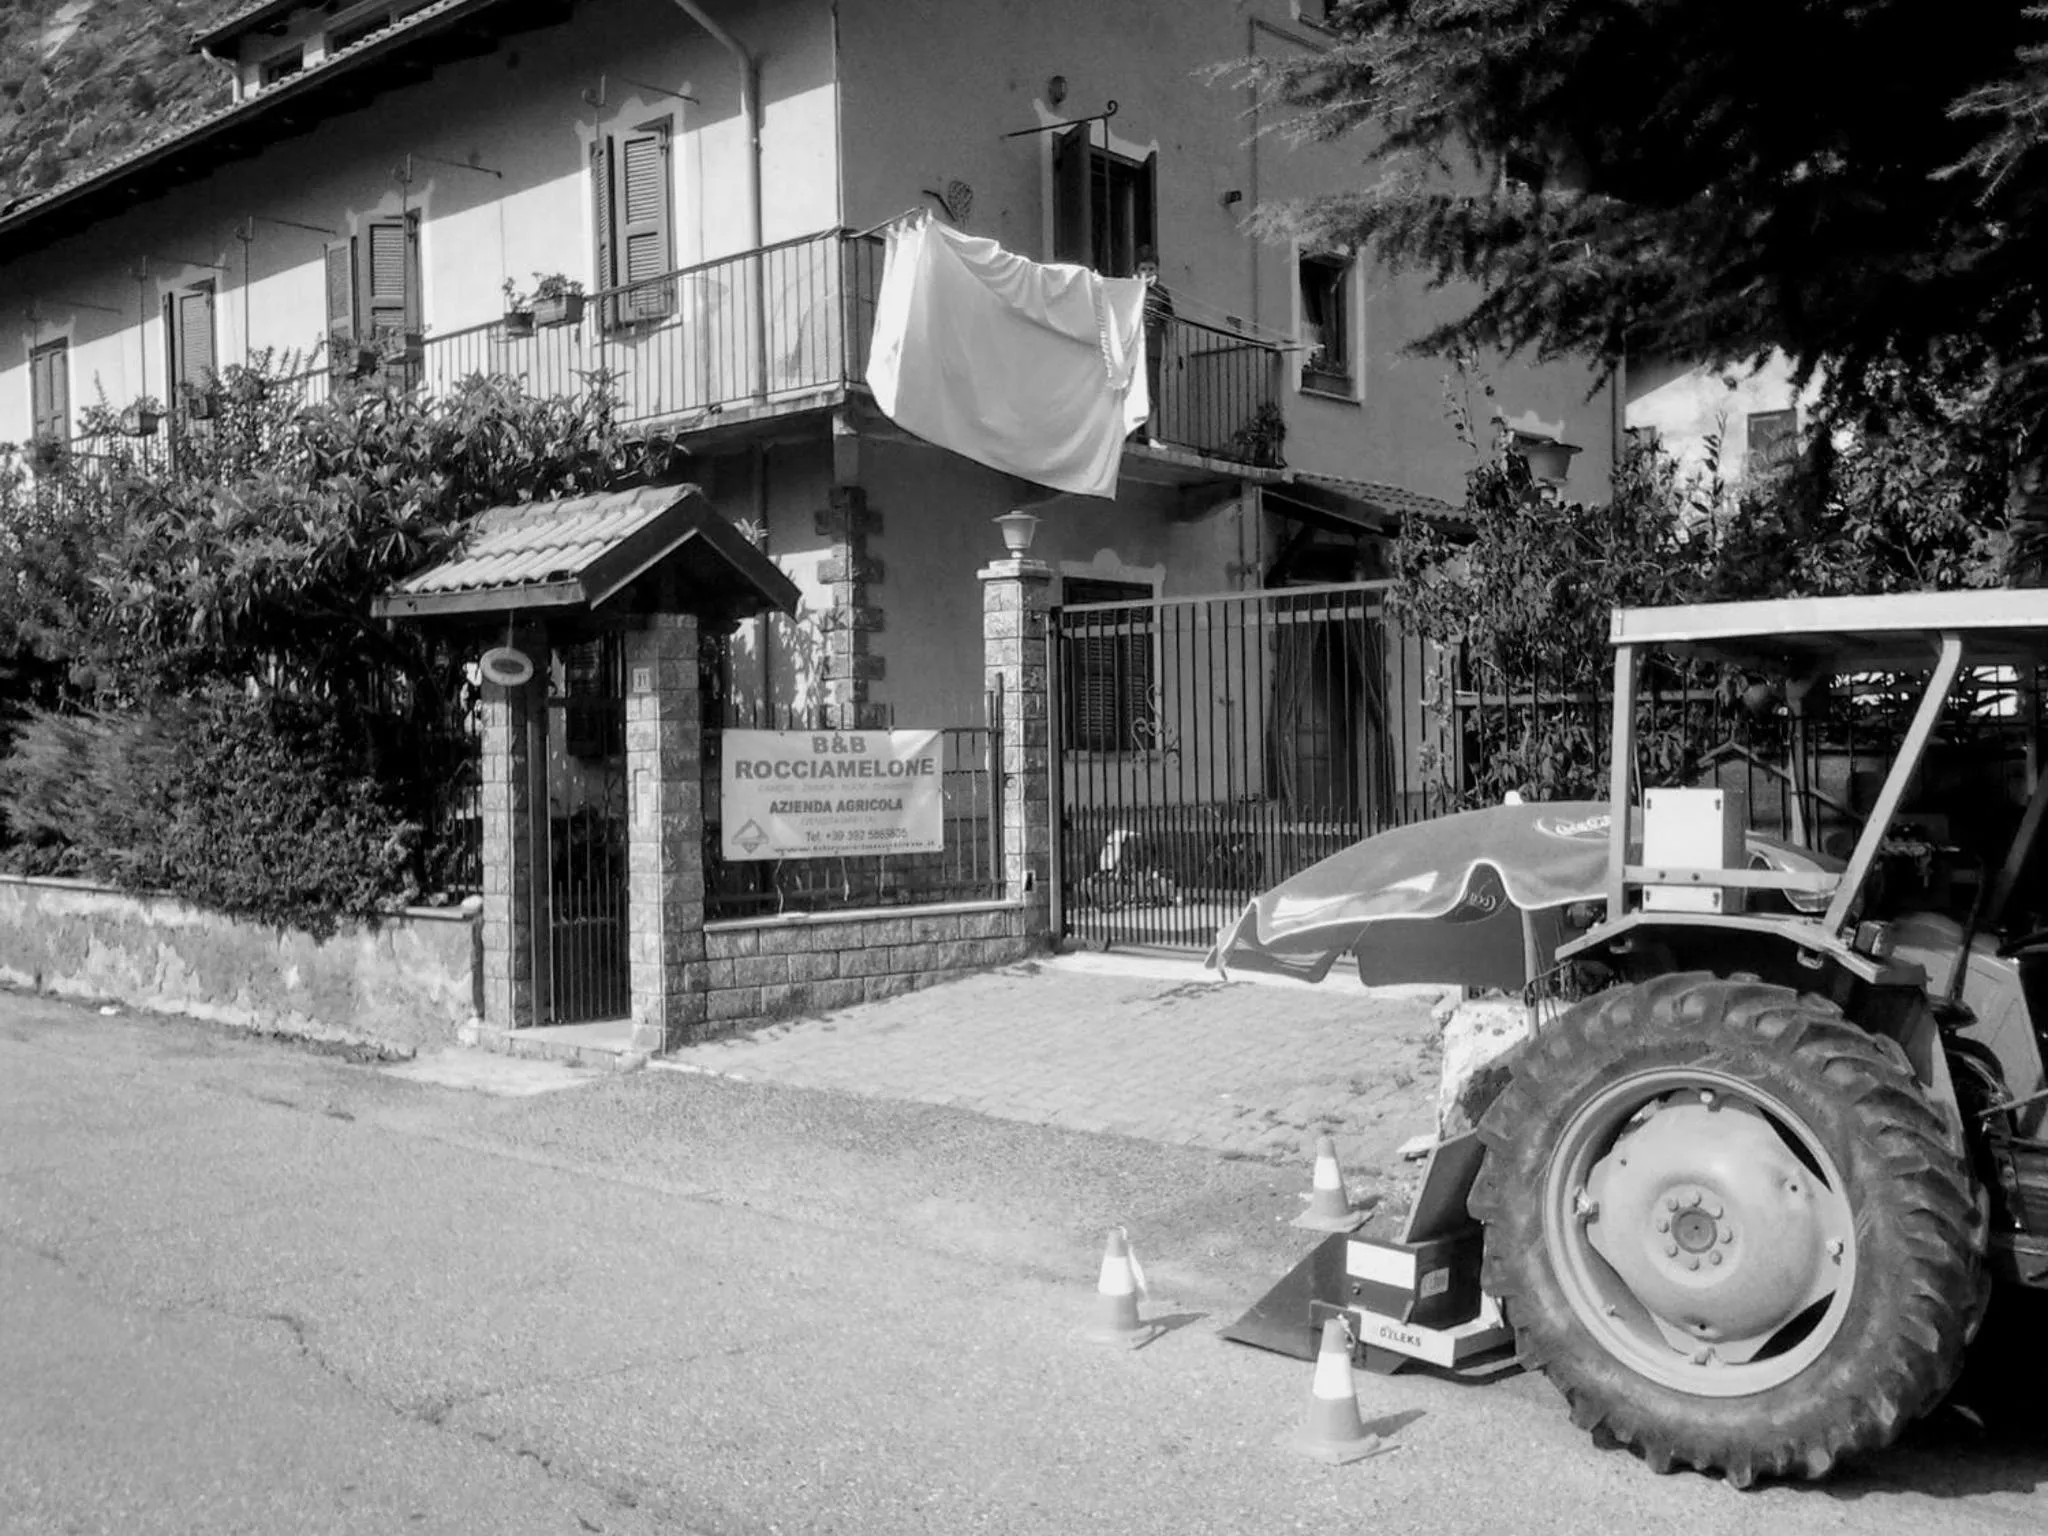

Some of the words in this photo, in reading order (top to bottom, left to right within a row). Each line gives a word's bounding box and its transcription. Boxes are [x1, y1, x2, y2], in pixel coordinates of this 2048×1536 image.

[812, 734, 867, 754] B&B
[735, 758, 935, 779] ROCCIAMELONE
[769, 800, 833, 814] AZIENDA
[836, 798, 903, 813] AGRICOLA
